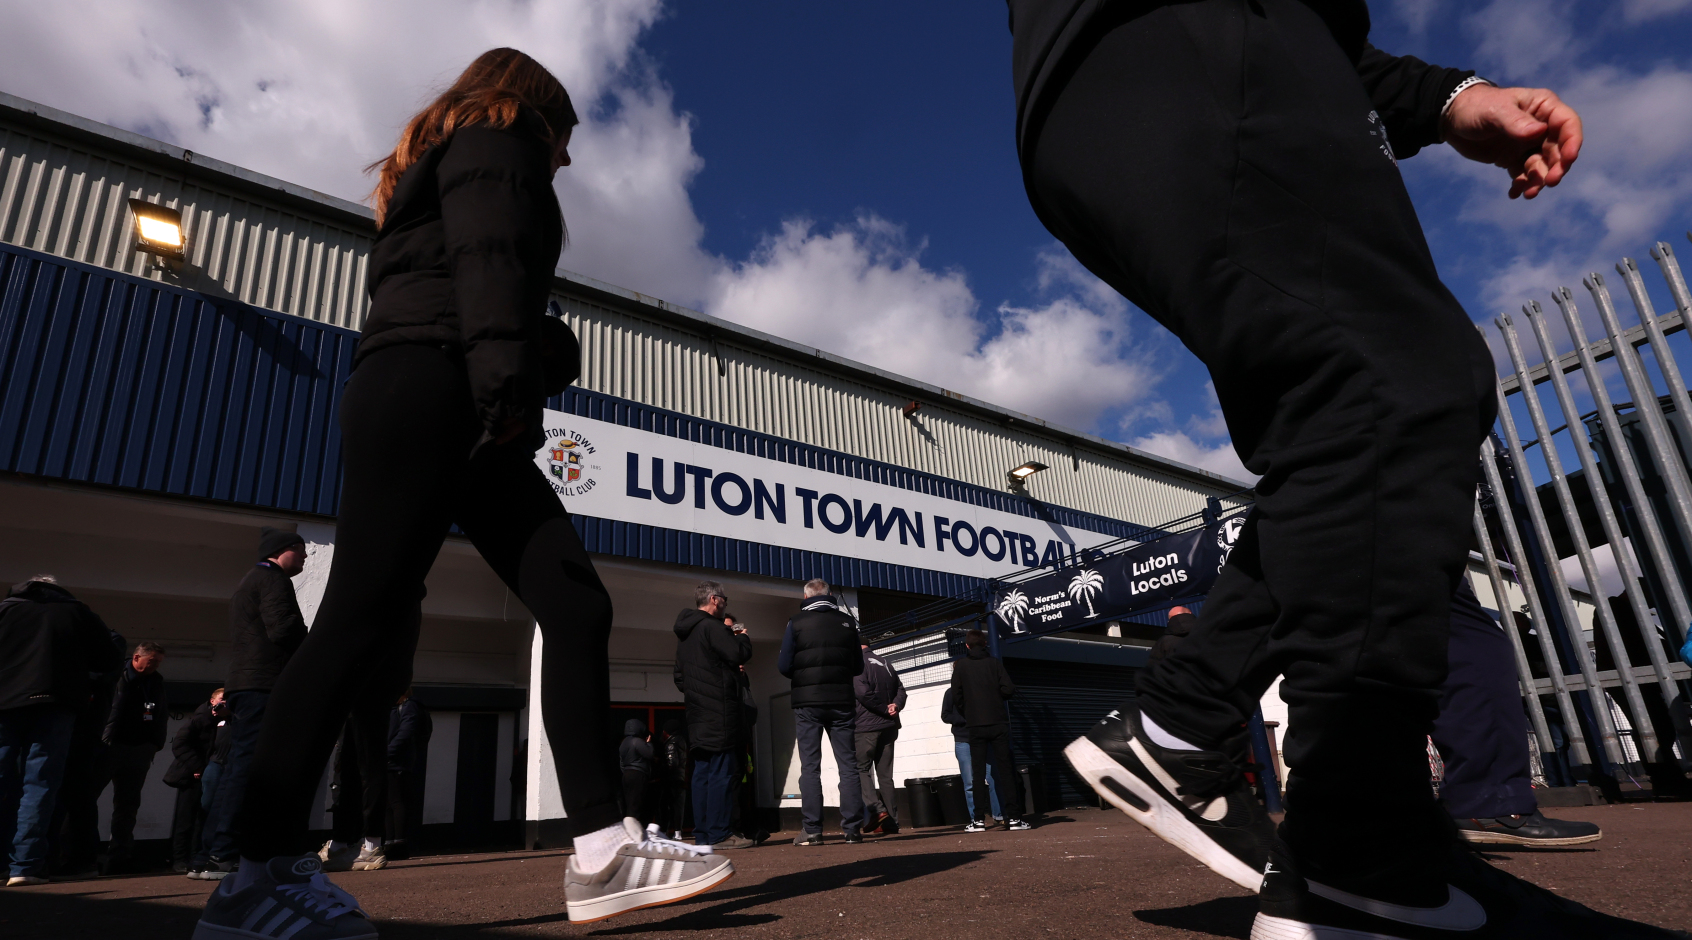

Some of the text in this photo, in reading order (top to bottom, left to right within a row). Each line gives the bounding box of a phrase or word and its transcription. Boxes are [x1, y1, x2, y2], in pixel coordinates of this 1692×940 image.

[544, 428, 596, 455] TON TOWN
[546, 478, 597, 496] TBALL CLUB
[626, 452, 787, 524] LUTON
[795, 487, 925, 549] TOWN
[1132, 552, 1179, 577] Luton
[1130, 567, 1188, 595] Locals
[1028, 599, 1072, 616] Caribbean
[1034, 590, 1066, 605] Norm's
[1041, 611, 1063, 623] Food
